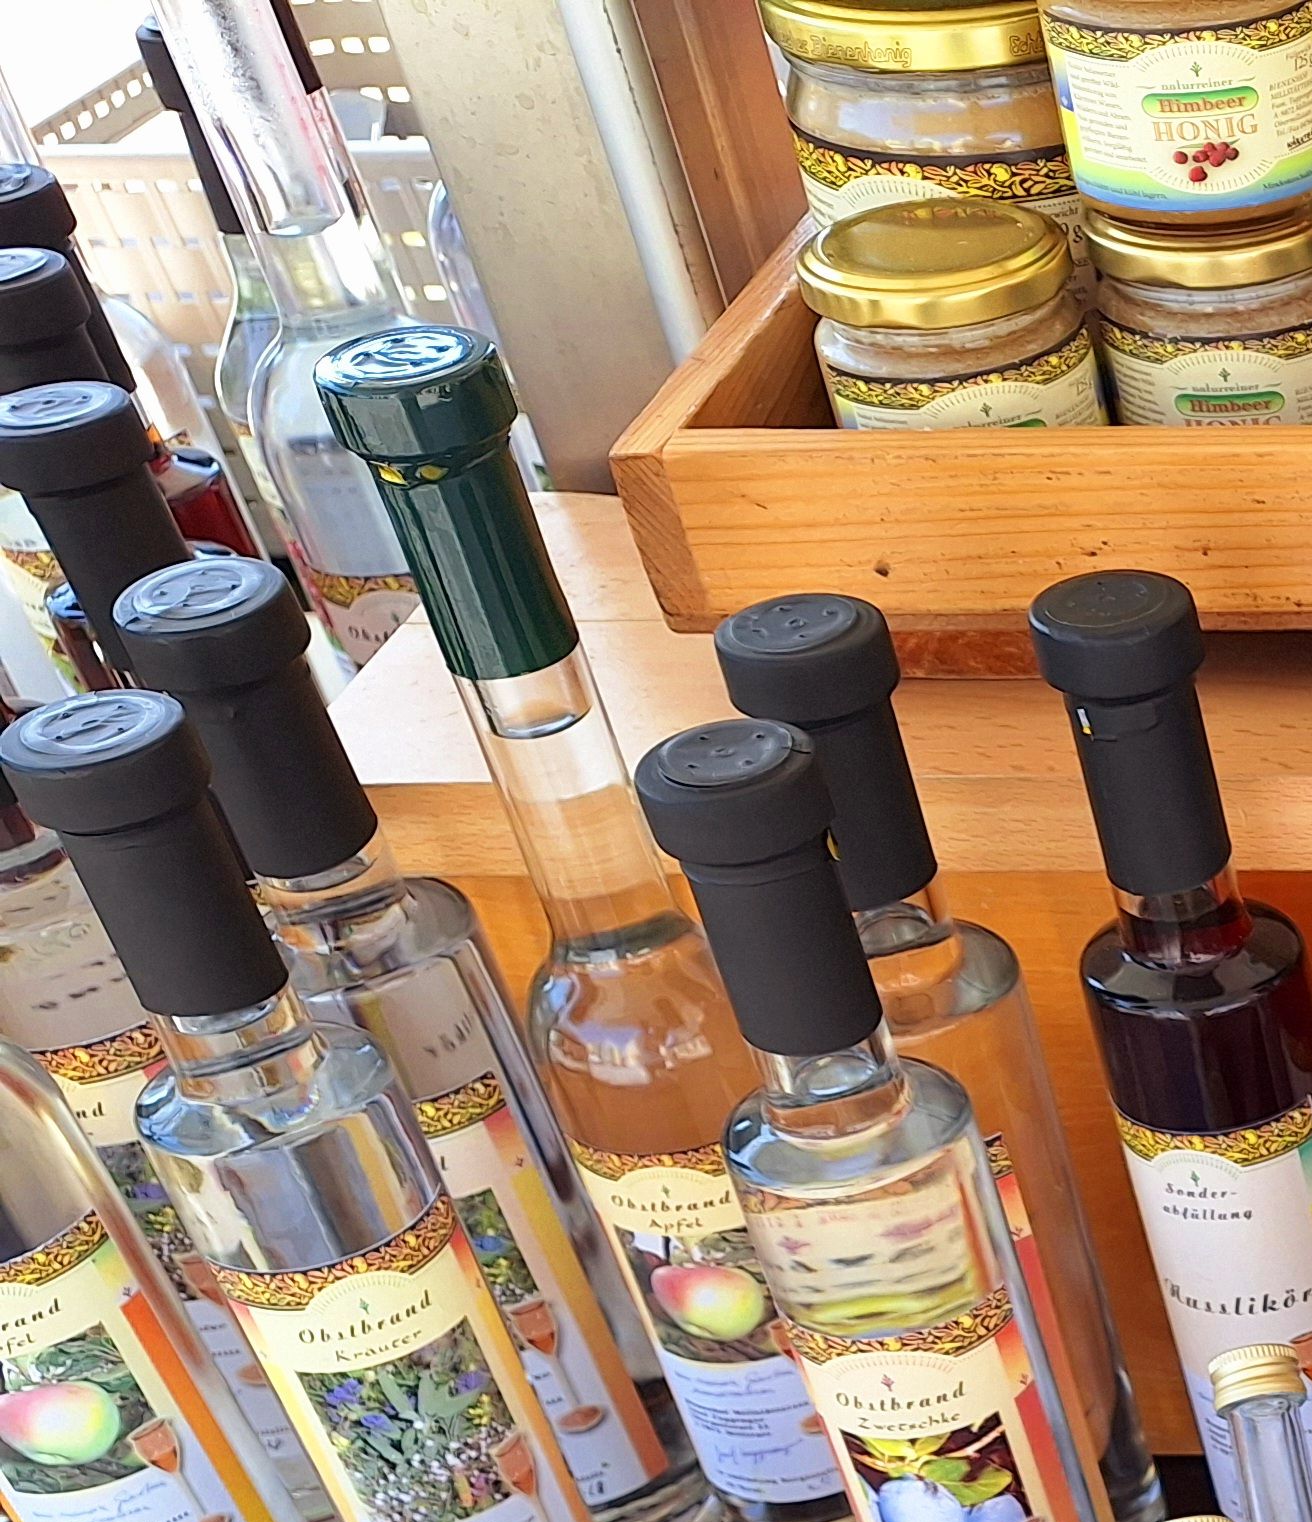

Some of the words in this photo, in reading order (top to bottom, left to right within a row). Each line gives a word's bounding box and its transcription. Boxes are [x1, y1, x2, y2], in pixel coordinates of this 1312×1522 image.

[1161, 78, 1233, 90] naturreiner
[1157, 94, 1247, 113] Himbeer
[1152, 114, 1258, 142] HONIG
[1188, 399, 1271, 414] Himbeer
[610, 1189, 732, 1212] Obstbrand
[1165, 1182, 1238, 1200] Sonder-
[1162, 1203, 1254, 1222] abfüllung
[648, 1217, 704, 1234] Apfel
[298, 1289, 433, 1346] Obstbrand
[835, 1380, 967, 1414] Obstbrand
[857, 1411, 962, 1434] Zwetschke
